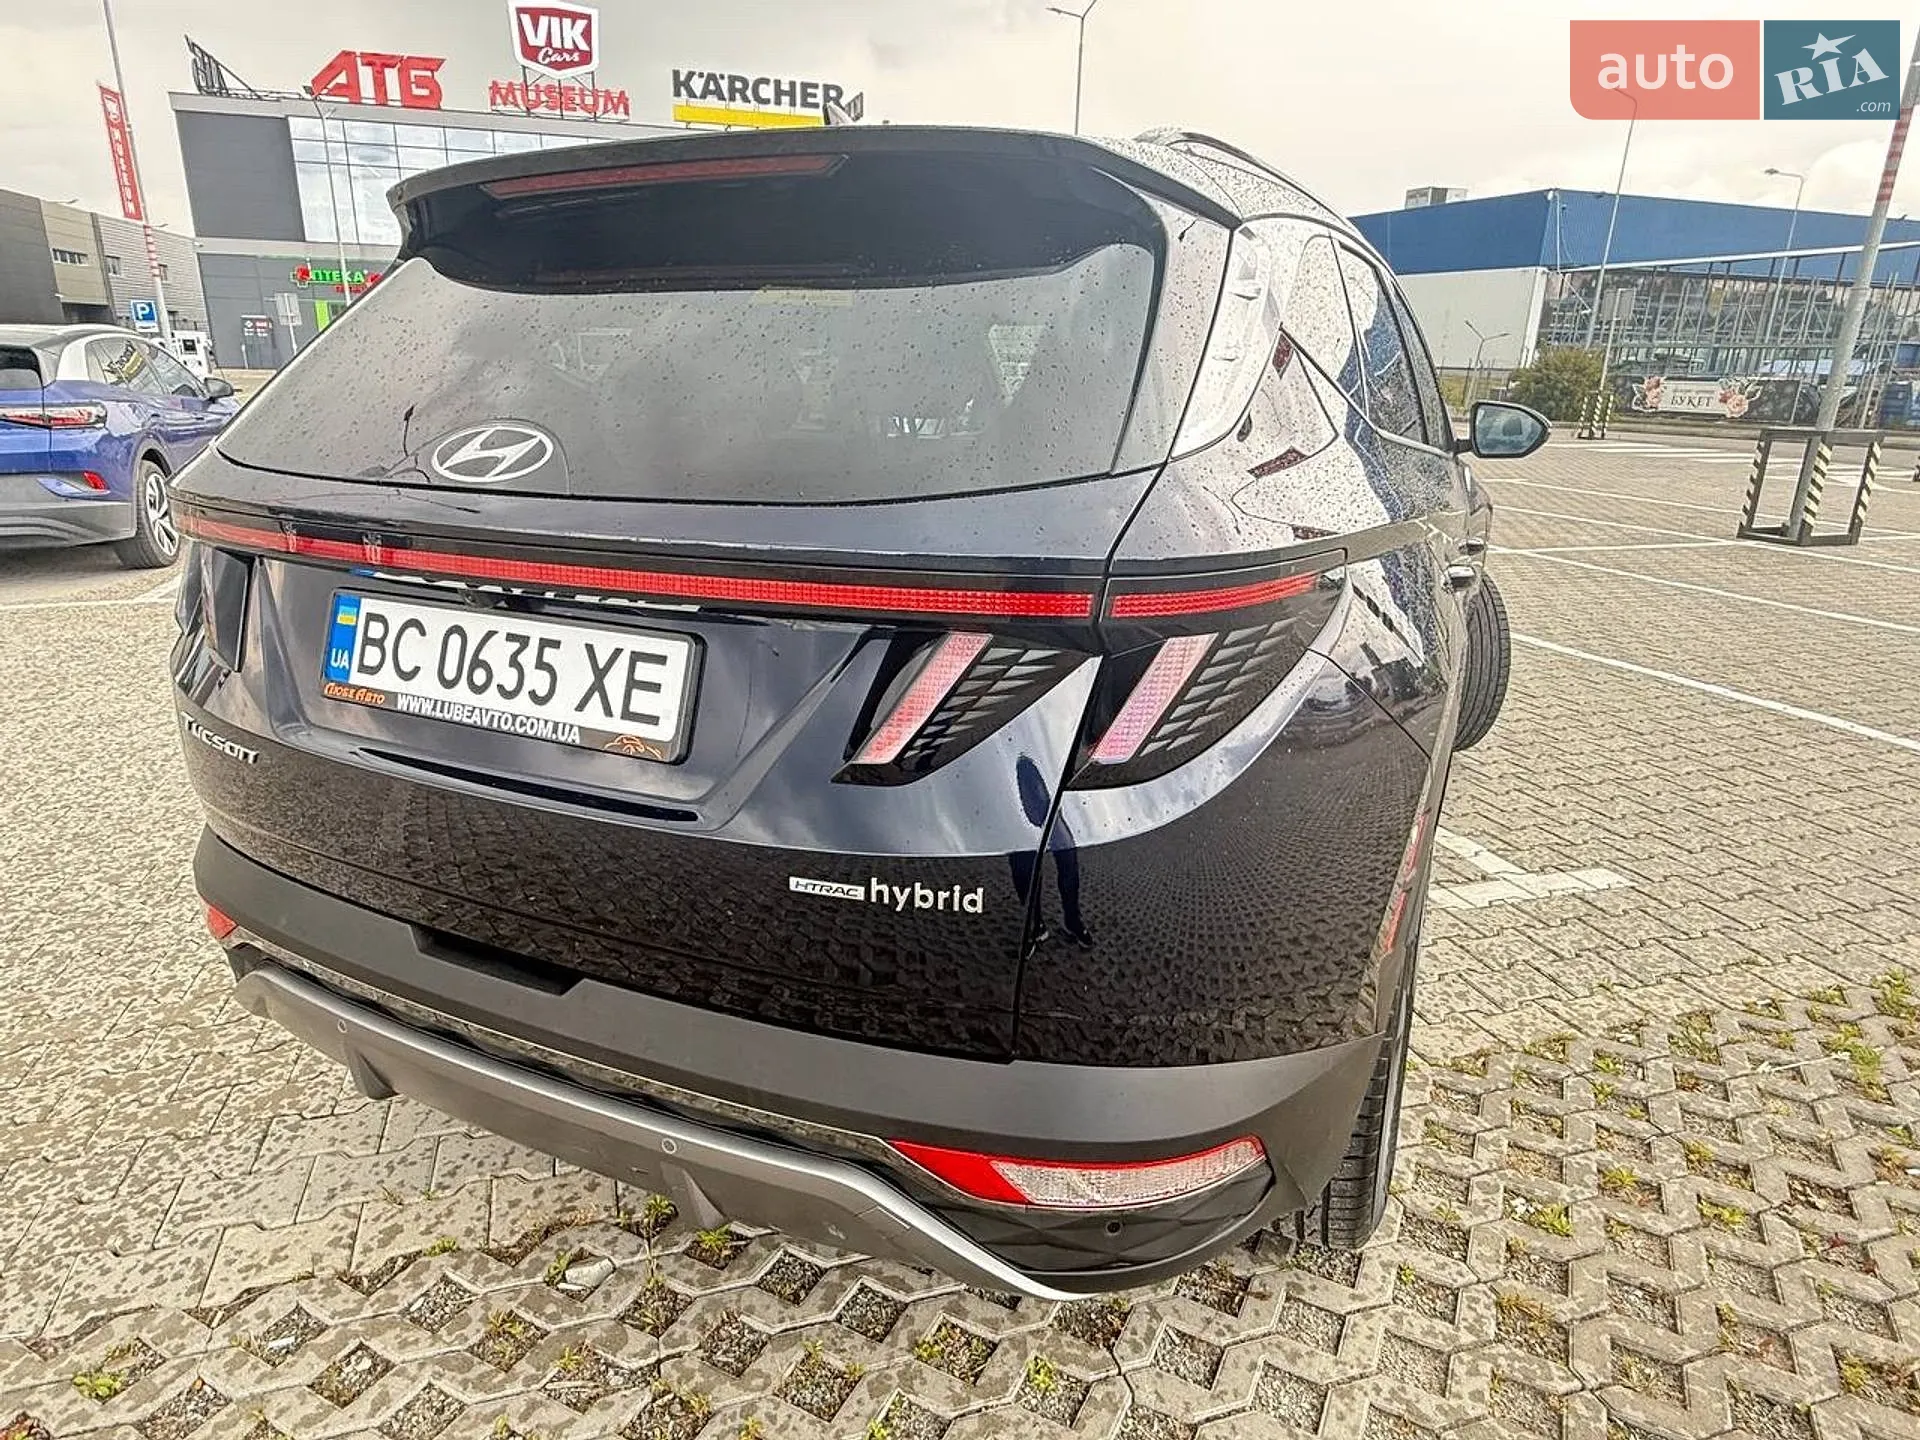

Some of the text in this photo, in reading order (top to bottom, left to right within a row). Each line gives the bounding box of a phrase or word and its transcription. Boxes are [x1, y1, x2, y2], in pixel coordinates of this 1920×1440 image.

[519, 13, 592, 52] VIK
[538, 46, 580, 64] Cars
[489, 80, 630, 117] MUSEUM
[672, 69, 846, 111] KÄRCHER
[136, 303, 150, 320] P
[330, 647, 349, 670] UA
[357, 612, 668, 726] BC 0635 XE
[397, 693, 581, 744] WWW.LUBEAVTO.COM.UA
[795, 877, 984, 914] HTRAC hybrid
